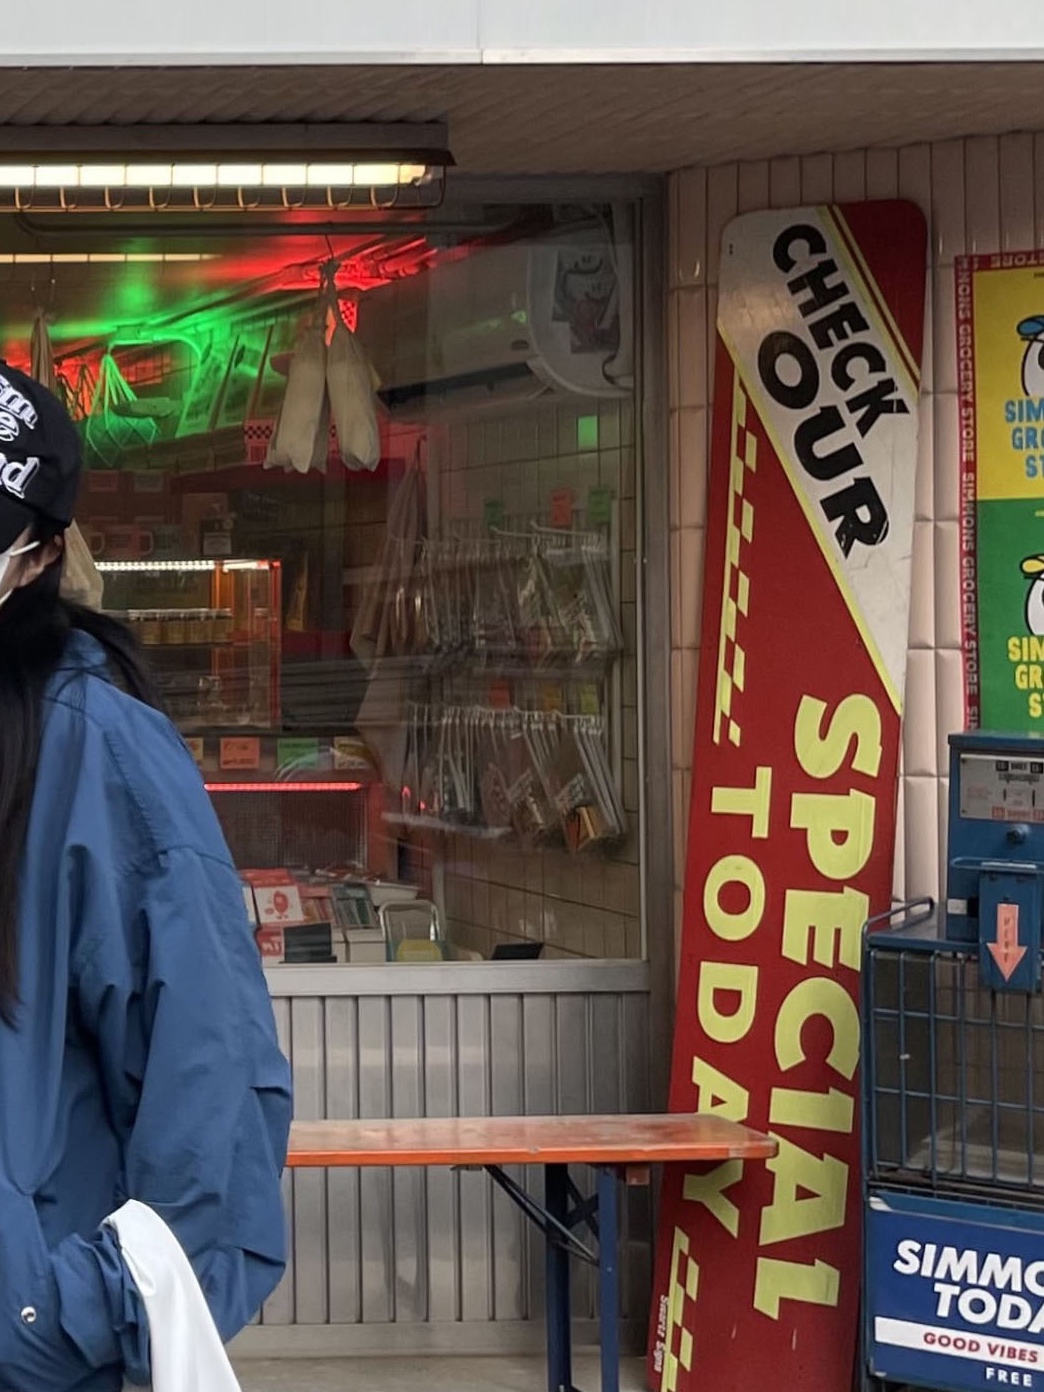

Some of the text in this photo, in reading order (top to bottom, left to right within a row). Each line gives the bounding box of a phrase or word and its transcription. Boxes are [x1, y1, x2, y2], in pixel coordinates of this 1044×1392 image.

[772, 223, 910, 439] CHECK
[757, 330, 890, 559] OUR
[961, 407, 974, 462] STORE
[1011, 426, 1044, 450] GR
[962, 472, 975, 551] SIMMONS
[963, 557, 977, 637] GROCERY
[964, 640, 978, 695] STORE
[682, 765, 773, 1239] TODAY
[753, 693, 883, 1320] SPECIAL
[923, 1332, 1039, 1364] GOOD VIBES
[986, 1367, 1033, 1387] FREE
